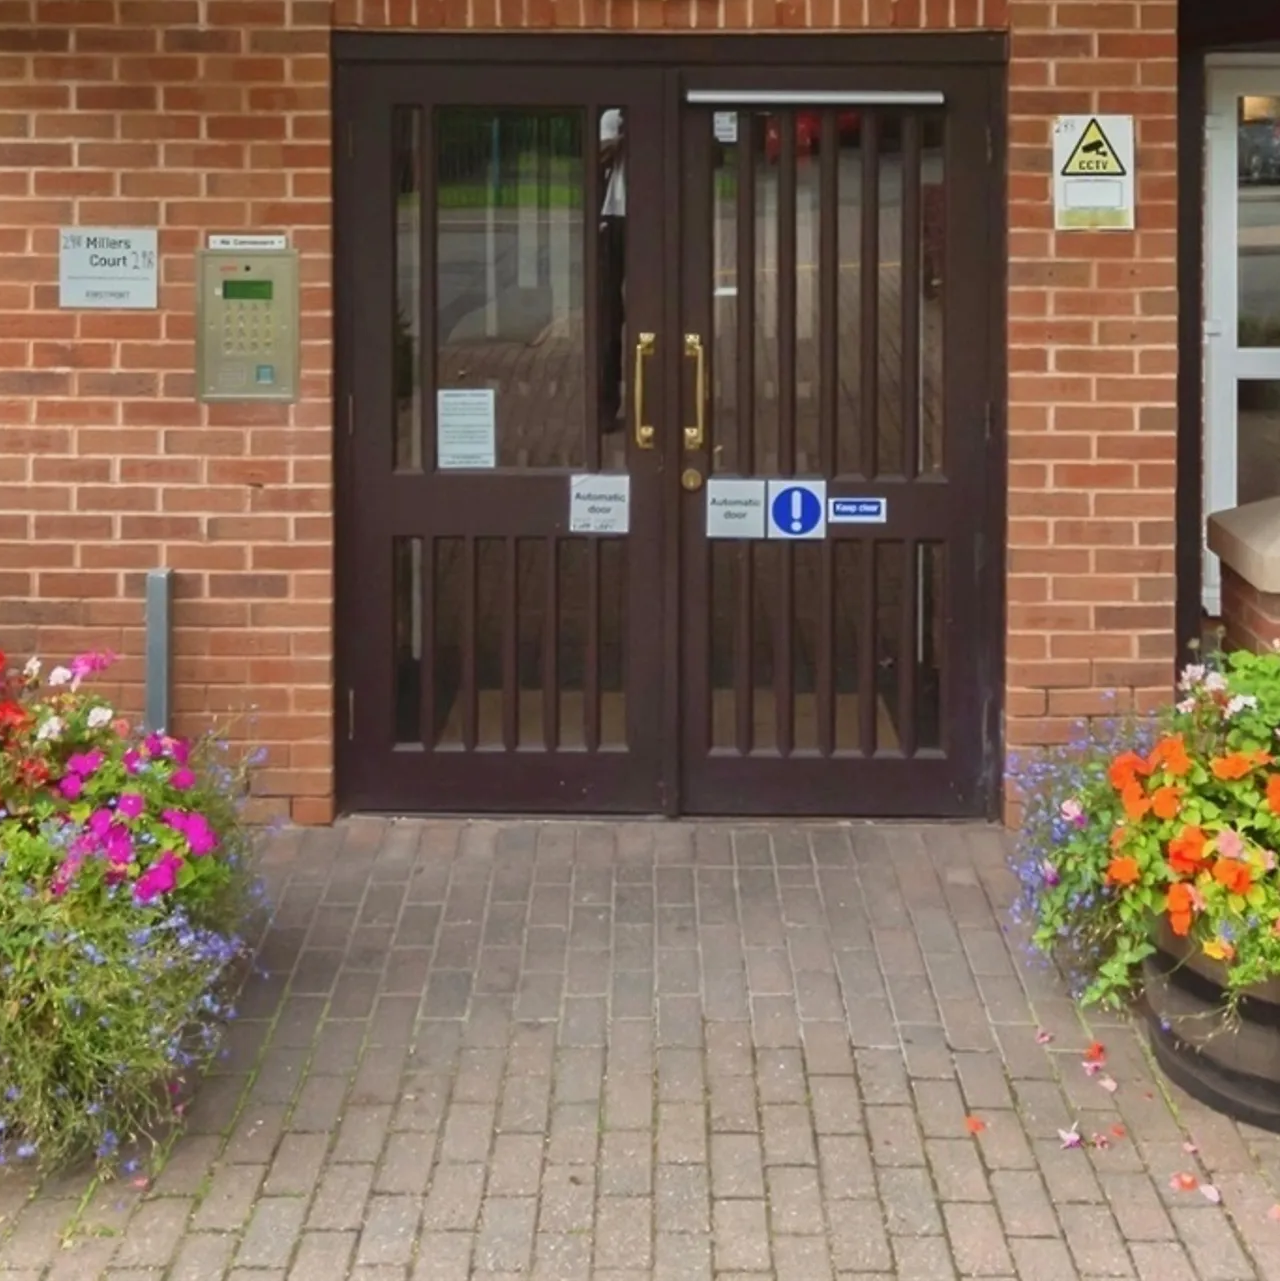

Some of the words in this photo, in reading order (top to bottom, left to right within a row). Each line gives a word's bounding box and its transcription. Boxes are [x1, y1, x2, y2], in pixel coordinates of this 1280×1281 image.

[1078, 160, 1108, 170] CCTV
[86, 236, 131, 249] Millers
[89, 253, 128, 268] Court
[575, 492, 626, 502] Automatic
[710, 497, 761, 507] Automatic
[587, 505, 612, 514] door
[723, 510, 748, 520] door
